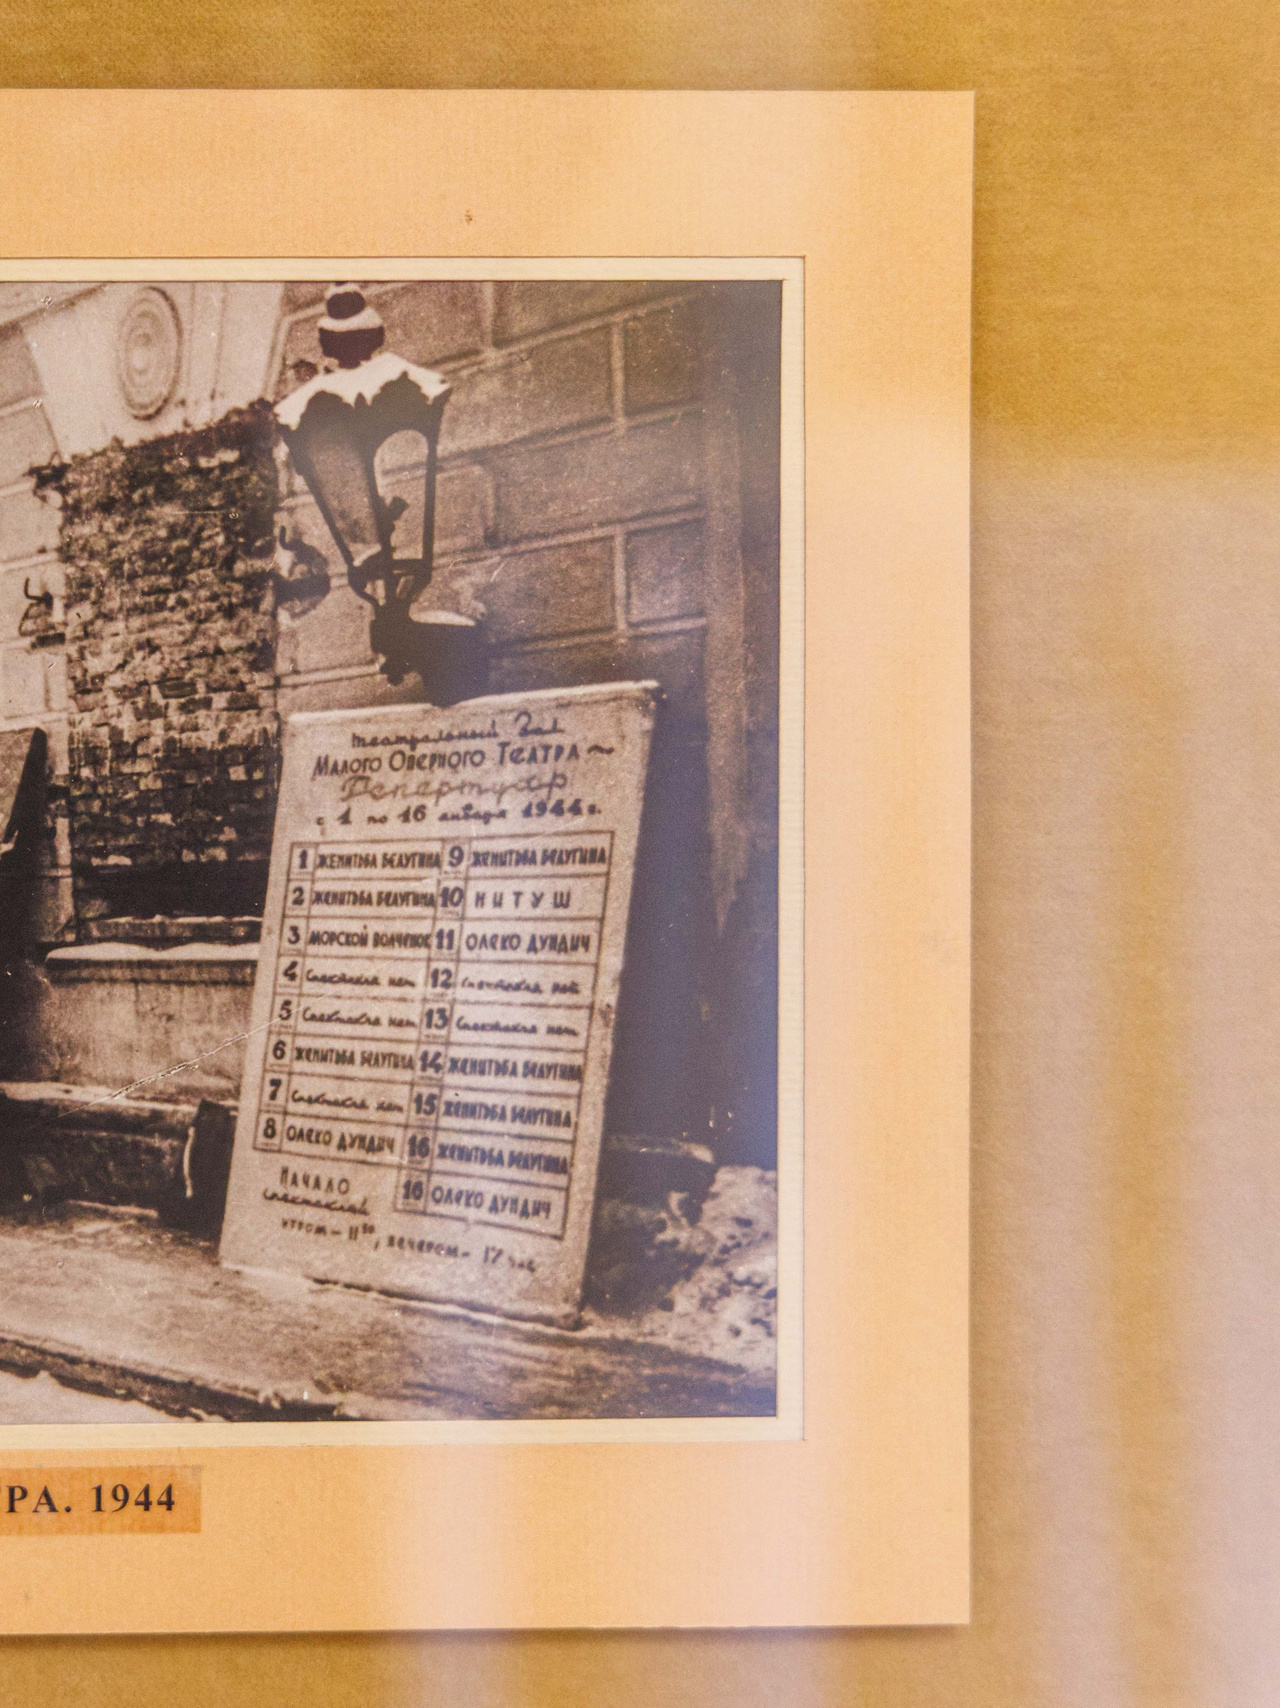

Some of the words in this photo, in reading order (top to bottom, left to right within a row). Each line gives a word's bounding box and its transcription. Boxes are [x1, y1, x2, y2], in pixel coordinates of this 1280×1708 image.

[337, 807, 352, 825] 1
[397, 804, 427, 824] 16
[299, 849, 308, 869] 1
[448, 846, 464, 867] 9
[292, 886, 304, 905] 2
[440, 886, 464, 908] 10
[288, 925, 300, 944] 3
[436, 928, 454, 950] 11
[283, 961, 298, 981] 4
[431, 968, 452, 988] 12
[279, 1000, 292, 1020] 5
[425, 1007, 449, 1029] 13
[273, 1040, 286, 1060] 6
[420, 1050, 443, 1073] 14
[270, 1078, 282, 1100] 7
[413, 1093, 437, 1115] 15
[263, 1118, 276, 1139] 8
[408, 1135, 430, 1158] 16
[402, 1180, 424, 1200] 16
[91, 1483, 176, 1512] 1944
